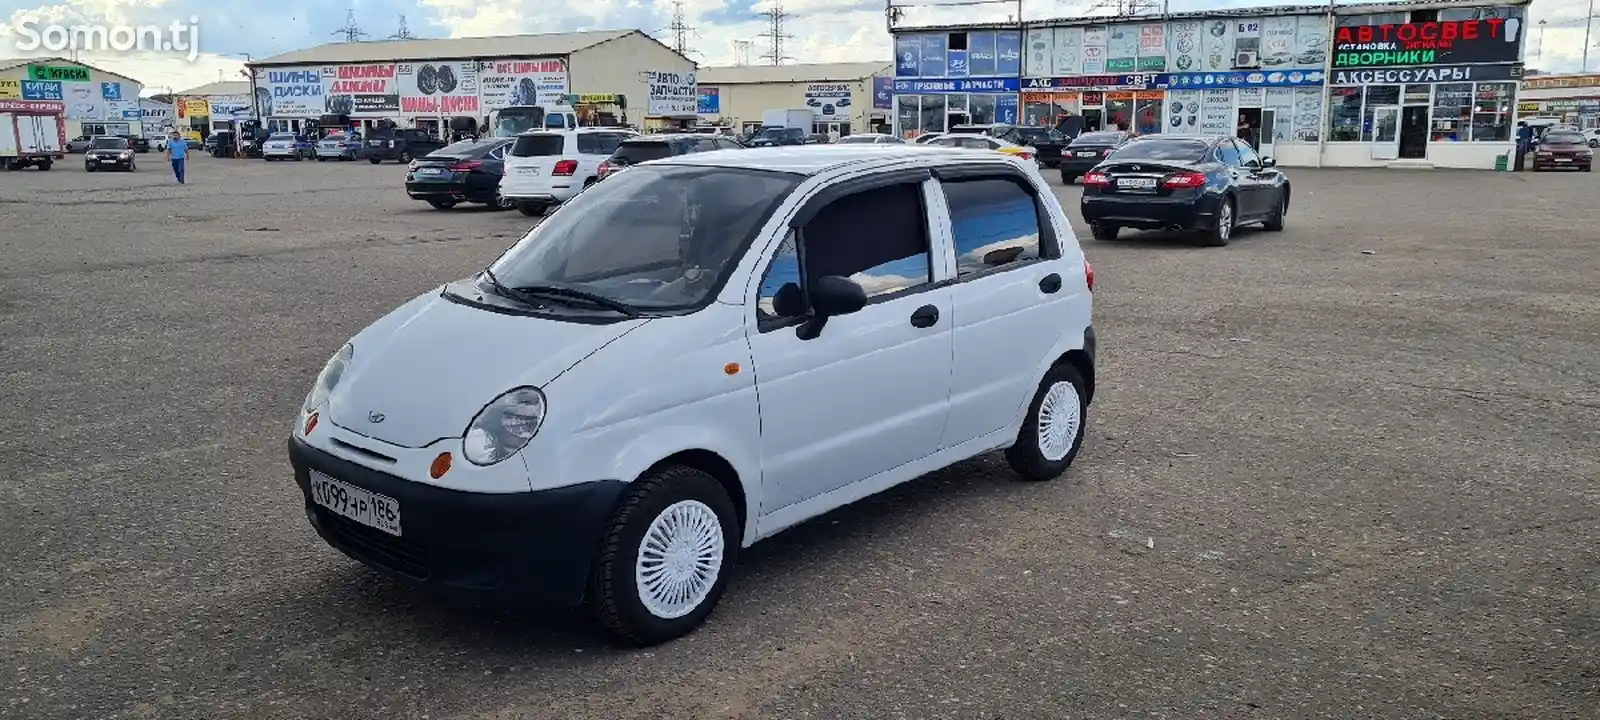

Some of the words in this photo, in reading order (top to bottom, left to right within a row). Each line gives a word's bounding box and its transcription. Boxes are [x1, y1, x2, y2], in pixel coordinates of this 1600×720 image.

[1337, 19, 1504, 43] АВТОСВЕТ
[1336, 50, 1435, 66] ДВОРНИКИ
[269, 70, 320, 84] ШИНЫ
[656, 72, 679, 85] АВТО
[1029, 78, 1052, 88] АКБ
[1126, 74, 1158, 85] СВЕТ
[1336, 67, 1471, 84] АКСЕССУАРЫ
[274, 85, 322, 99] ДИСКИ
[650, 84, 696, 96] ЗАПЧАСТИ
[961, 80, 1005, 90] ЗАПЧАСТИ
[371, 497, 397, 522] 186
